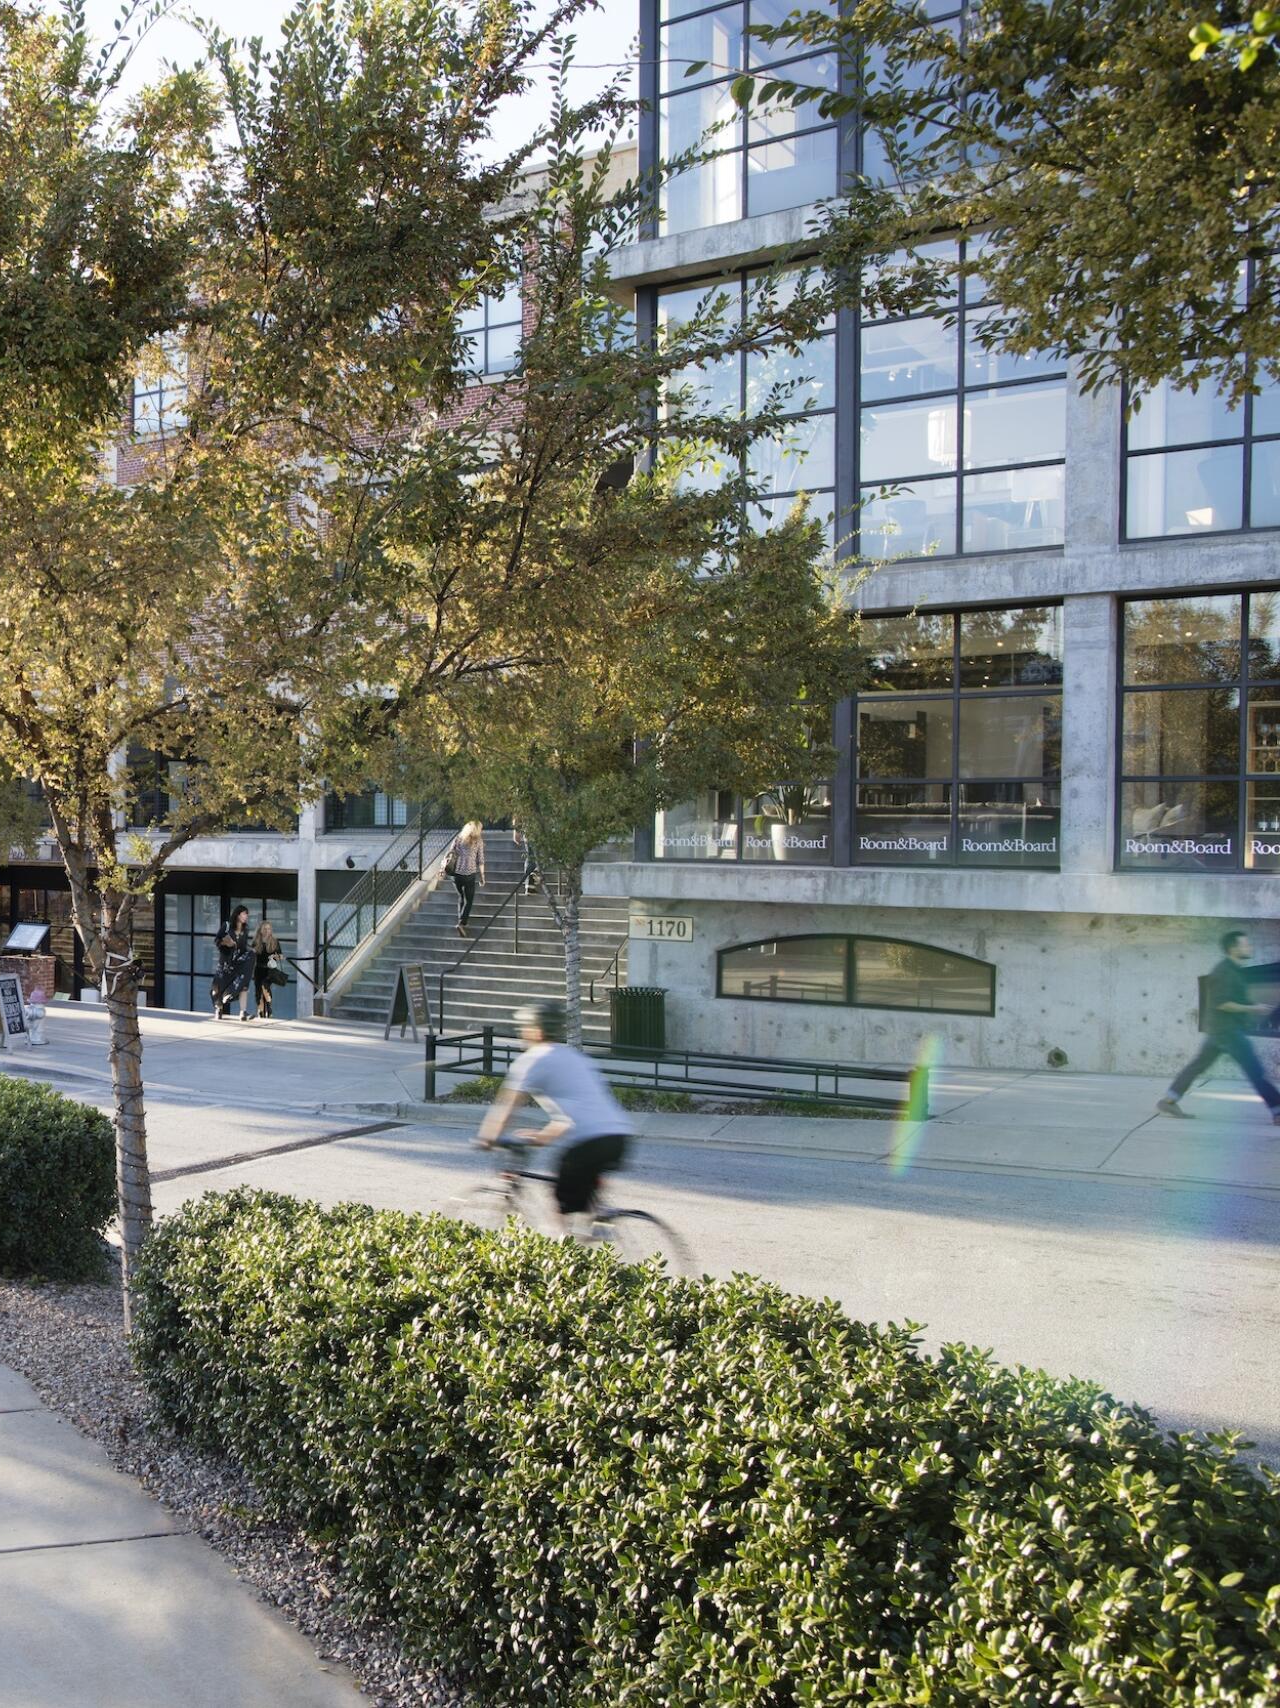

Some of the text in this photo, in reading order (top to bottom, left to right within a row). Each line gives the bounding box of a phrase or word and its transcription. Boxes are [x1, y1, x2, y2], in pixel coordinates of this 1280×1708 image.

[859, 836, 947, 851] Room&Board
[962, 837, 1056, 852] Room&Board
[1125, 839, 1232, 855] Room&Board
[647, 919, 687, 937] 1170
